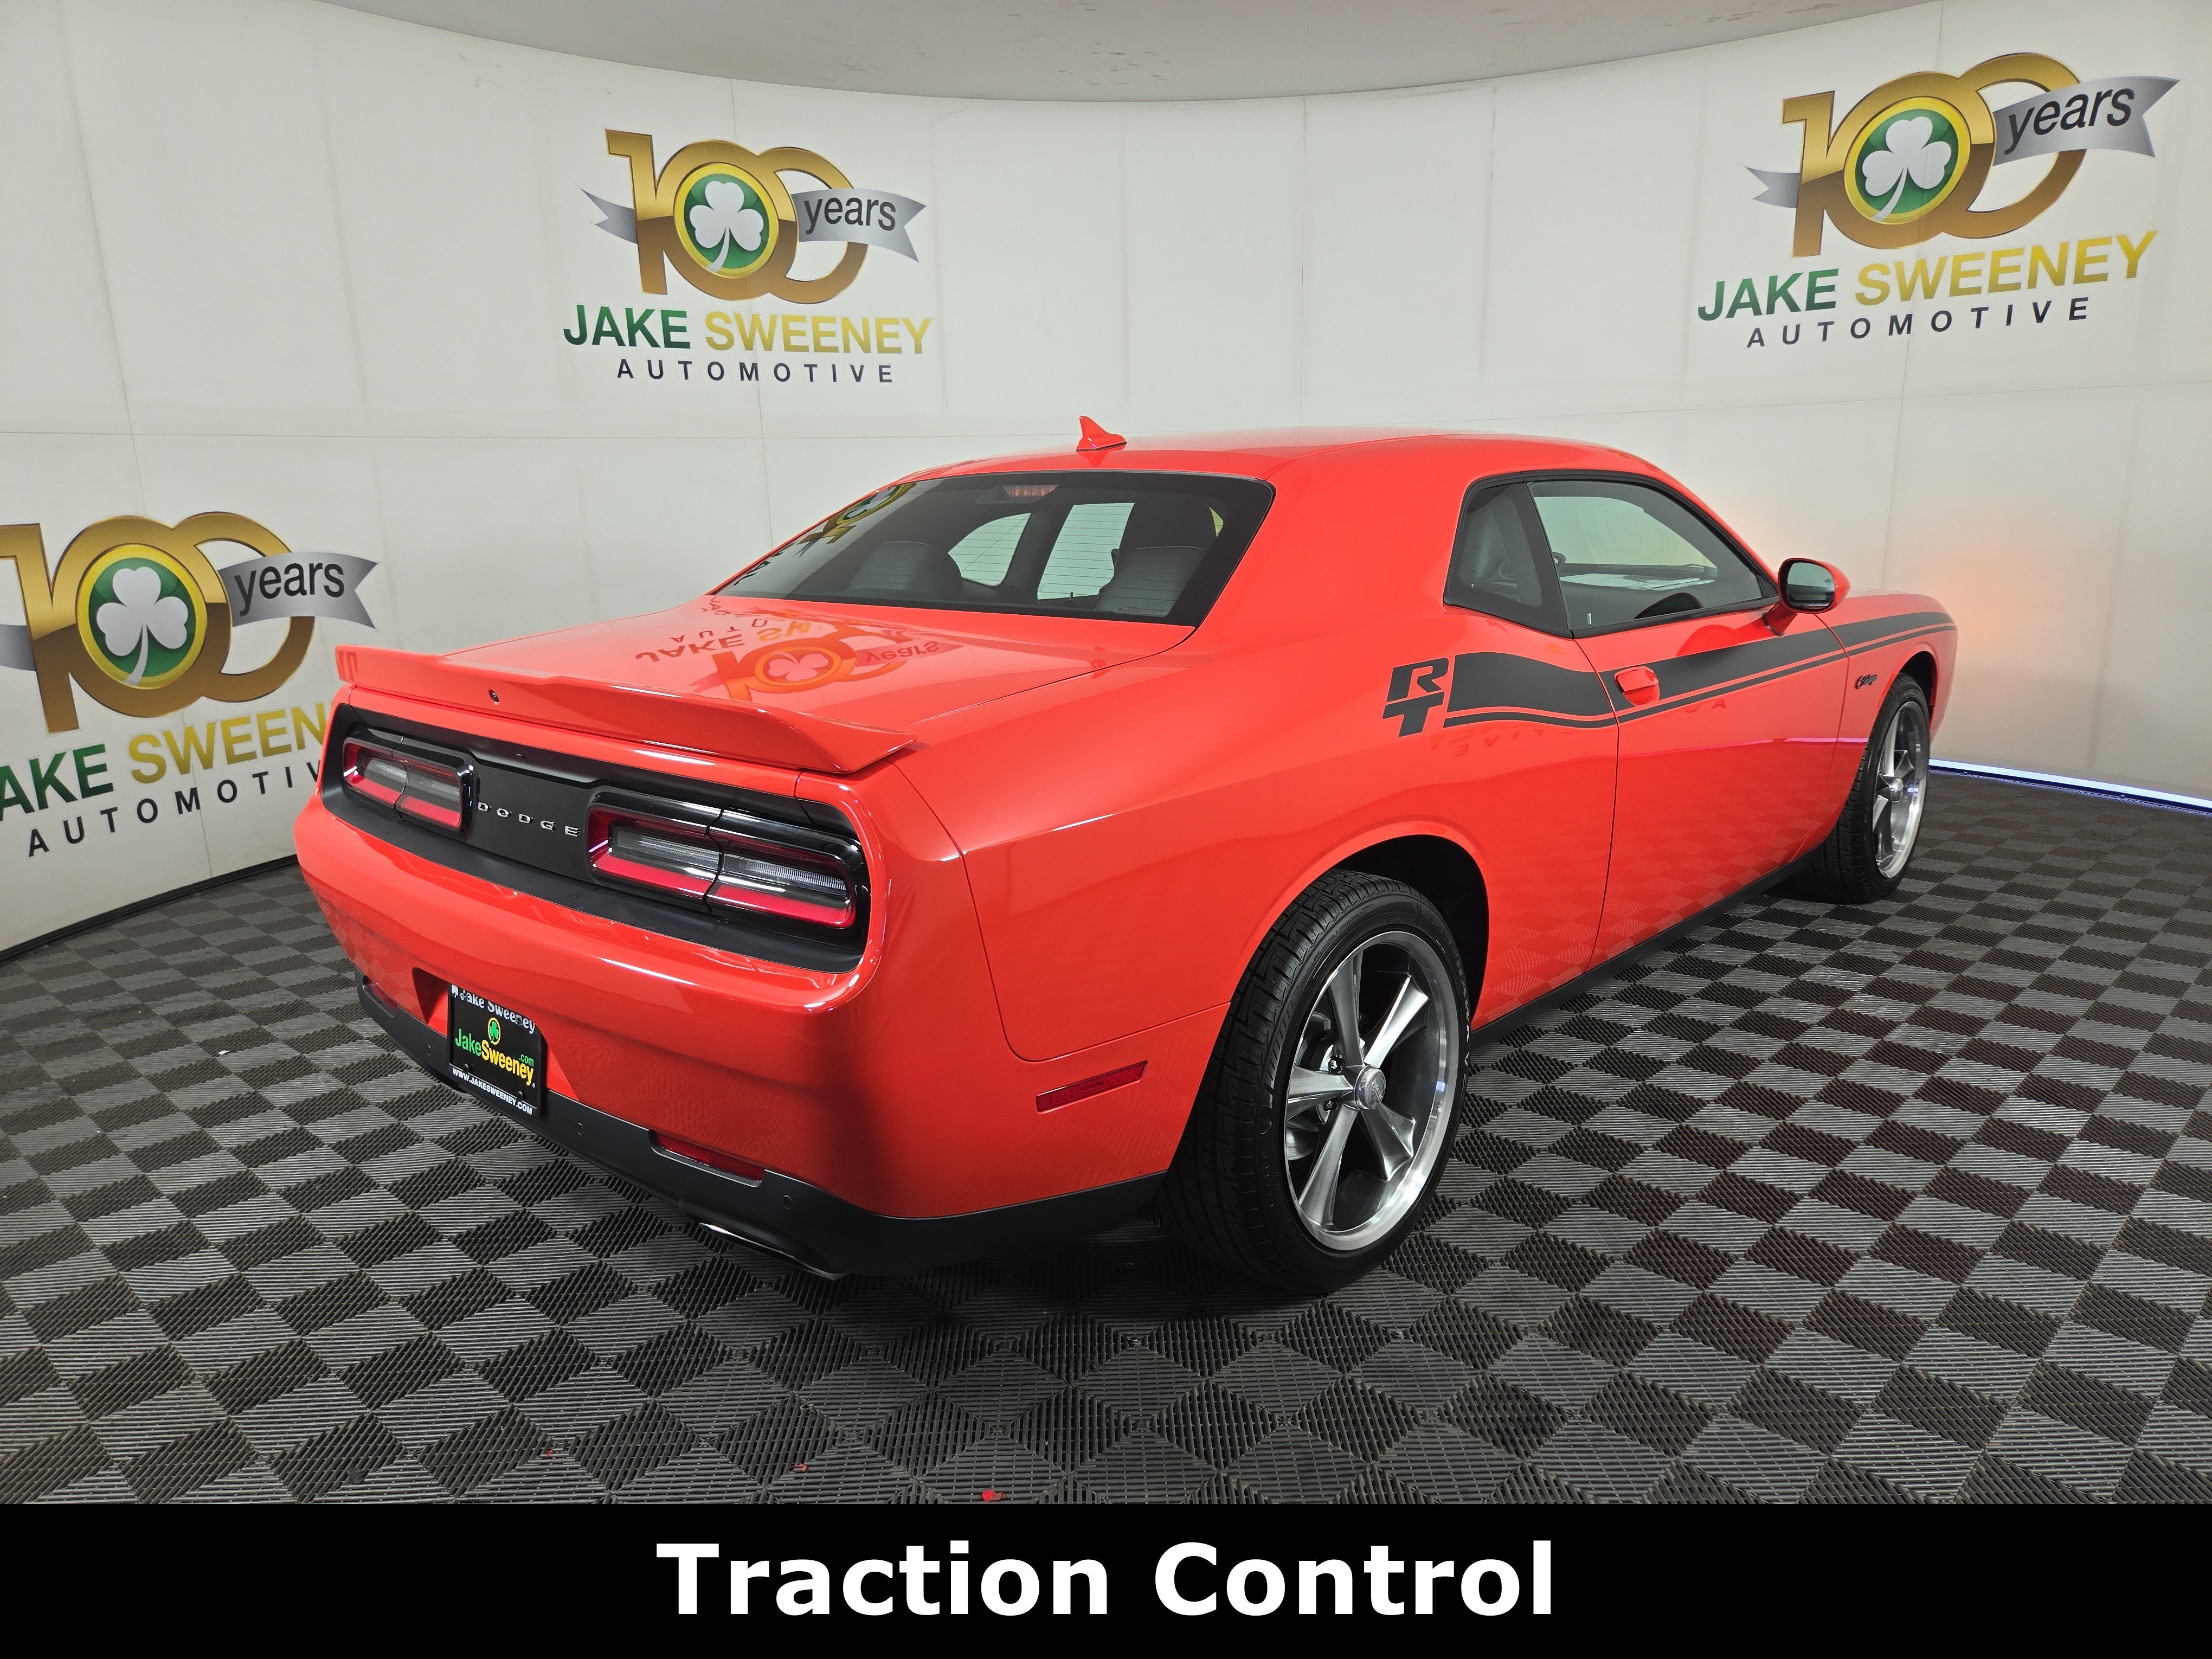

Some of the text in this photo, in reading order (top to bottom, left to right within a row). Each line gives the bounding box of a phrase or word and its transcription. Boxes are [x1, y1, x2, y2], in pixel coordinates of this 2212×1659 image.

[2004, 88, 2134, 155] years
[804, 197, 896, 234] years
[1697, 230, 2158, 321] JAKE SWEENEY
[563, 305, 931, 354] JAKE SWEENEY
[1746, 297, 2088, 348] AUTOMOTIVE
[616, 359, 892, 383] AUTOMOTIVE
[234, 563, 344, 616] years
[0, 702, 328, 822] AKE SWEEN
[29, 760, 321, 857] AUTOMOTIV
[478, 801, 581, 838] DODGE
[455, 1028, 534, 1086] JakeSweeney
[519, 1054, 535, 1067] .com
[452, 1067, 532, 1115] WWW.JAKESWEENEY.COM
